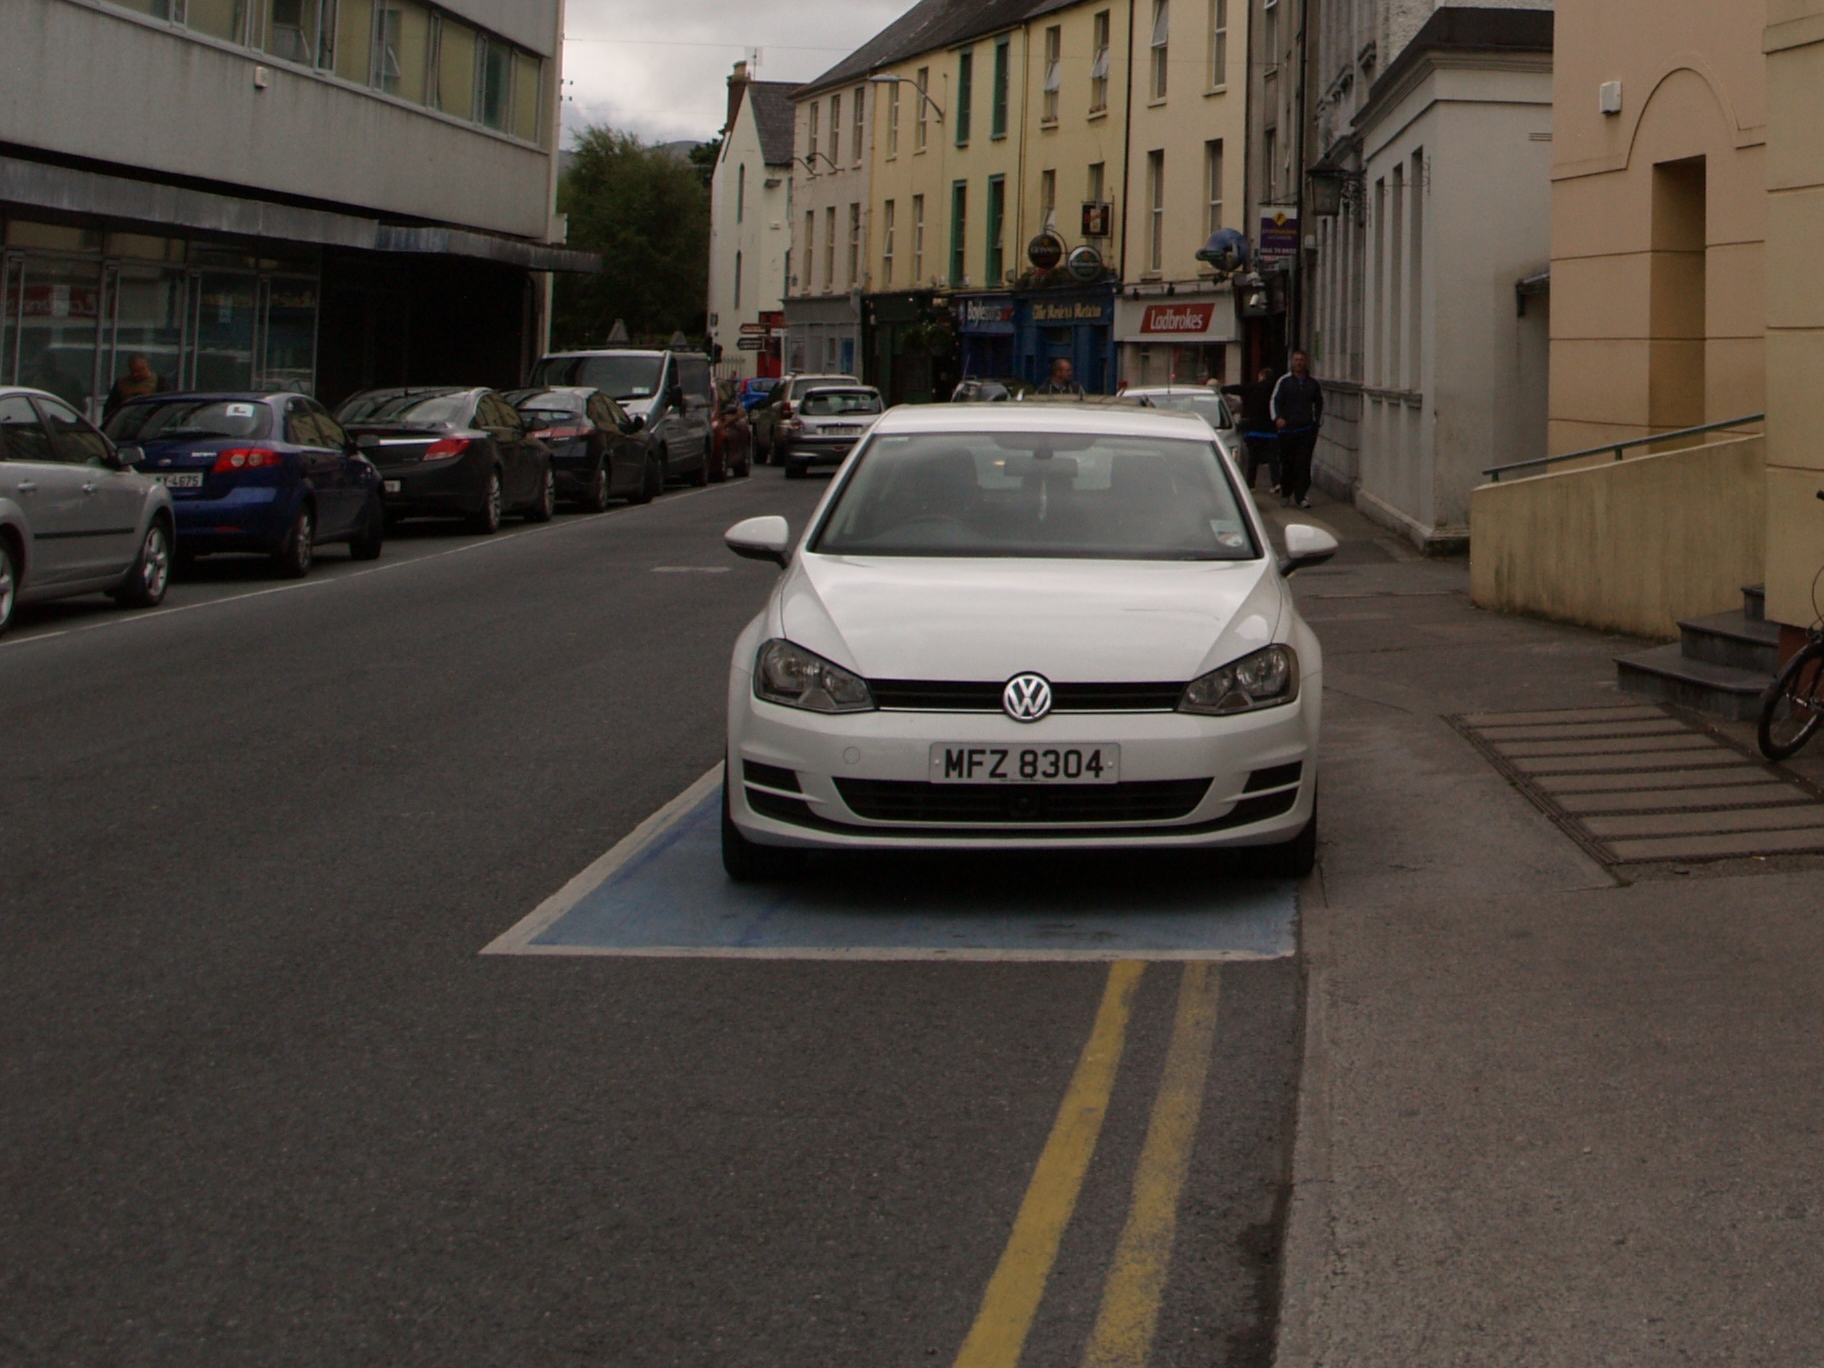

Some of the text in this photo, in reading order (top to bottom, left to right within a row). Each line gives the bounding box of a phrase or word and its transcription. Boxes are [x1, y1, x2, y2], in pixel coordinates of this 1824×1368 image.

[1150, 308, 1204, 330] Ladbrokes
[944, 749, 1104, 779] MFZ 8304
